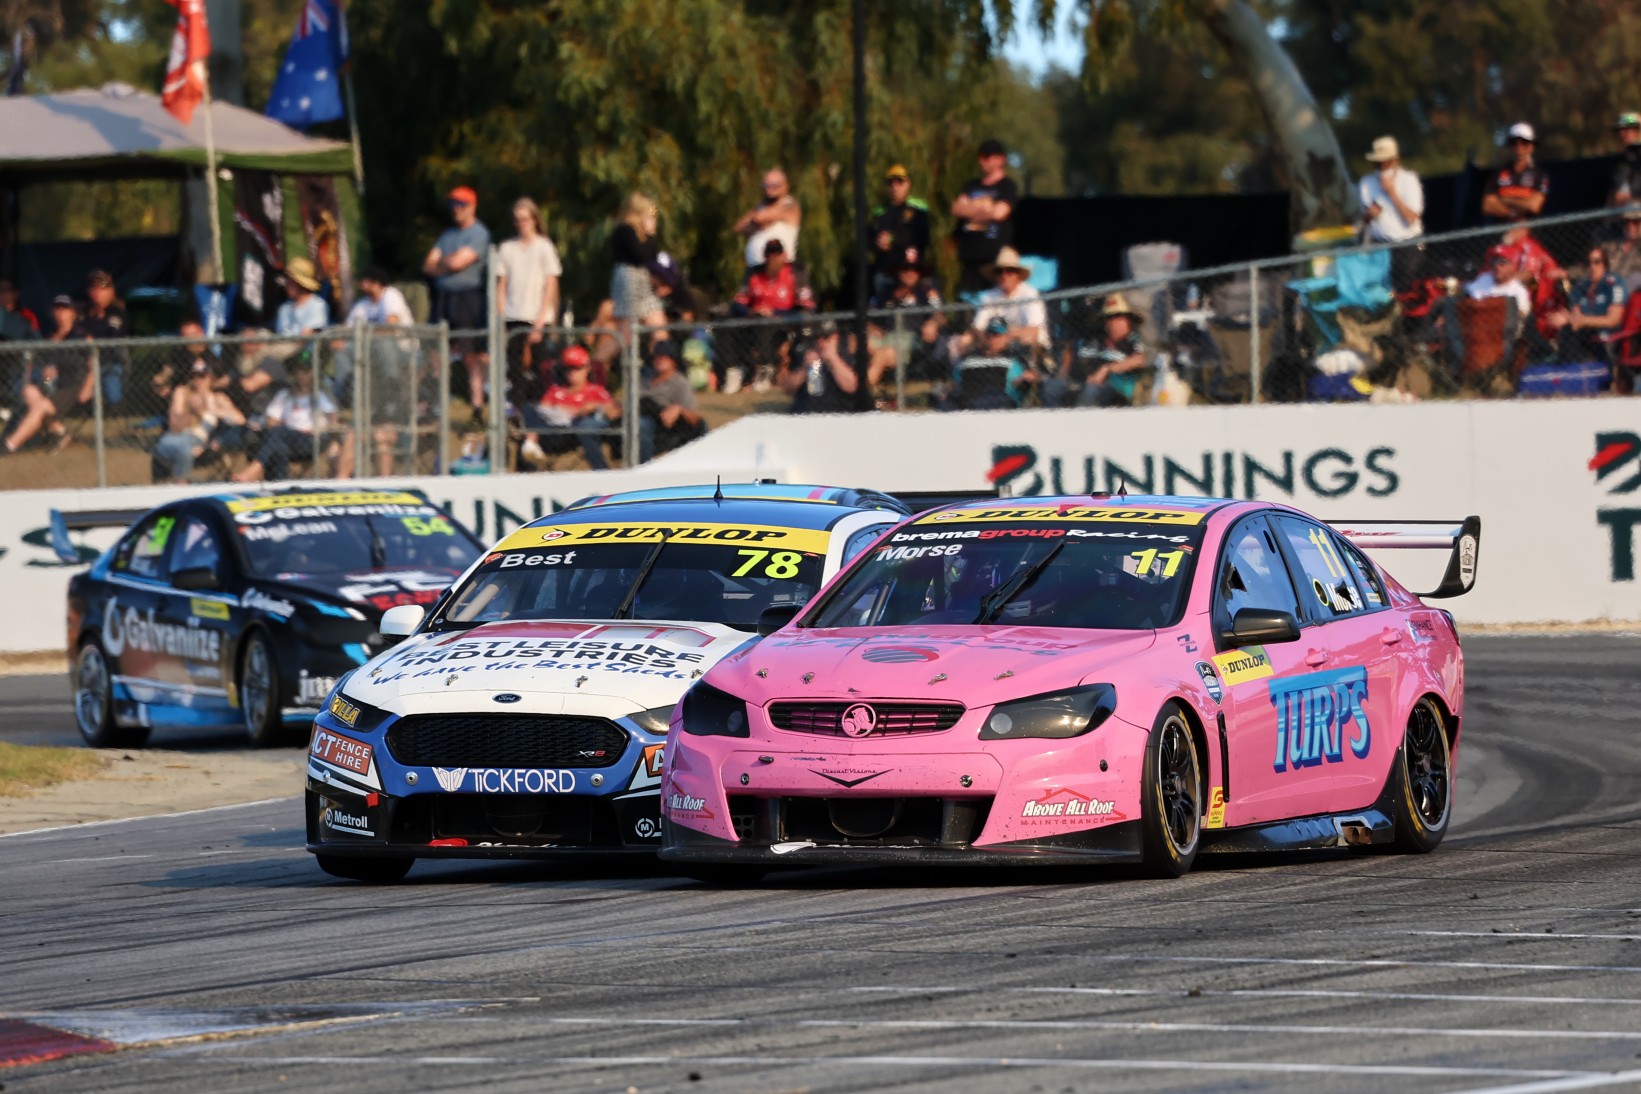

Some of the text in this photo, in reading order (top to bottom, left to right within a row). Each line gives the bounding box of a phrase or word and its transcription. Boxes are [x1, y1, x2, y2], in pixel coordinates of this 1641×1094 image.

[984, 445, 1400, 498] BUNNINGS
[969, 508, 1186, 520] DUNLOP
[401, 516, 454, 536] 54
[576, 527, 787, 542] DUNLOP
[500, 550, 577, 568] Best
[876, 544, 963, 562] Morse
[1309, 528, 1347, 577] 11
[731, 549, 803, 579] 78
[1131, 548, 1184, 577] 11
[398, 640, 705, 664] BEST LEISURE
[400, 649, 676, 668] INDUSTRIES
[373, 659, 687, 685] We have the Best Sheds
[1229, 654, 1265, 673] DUNLOP
[498, 694, 516, 702] Ford
[1268, 665, 1371, 774] TURPS
[311, 729, 370, 759] ACT FENCE
[335, 751, 363, 770] HIRE
[468, 768, 576, 793] TICKFORD
[671, 794, 682, 809] ALL
[682, 794, 705, 810] ROOF
[1022, 798, 1115, 817] ABOVE ALL ROOF
[334, 810, 368, 829] Metroll
[1020, 816, 1105, 826] MAINTENANCE
